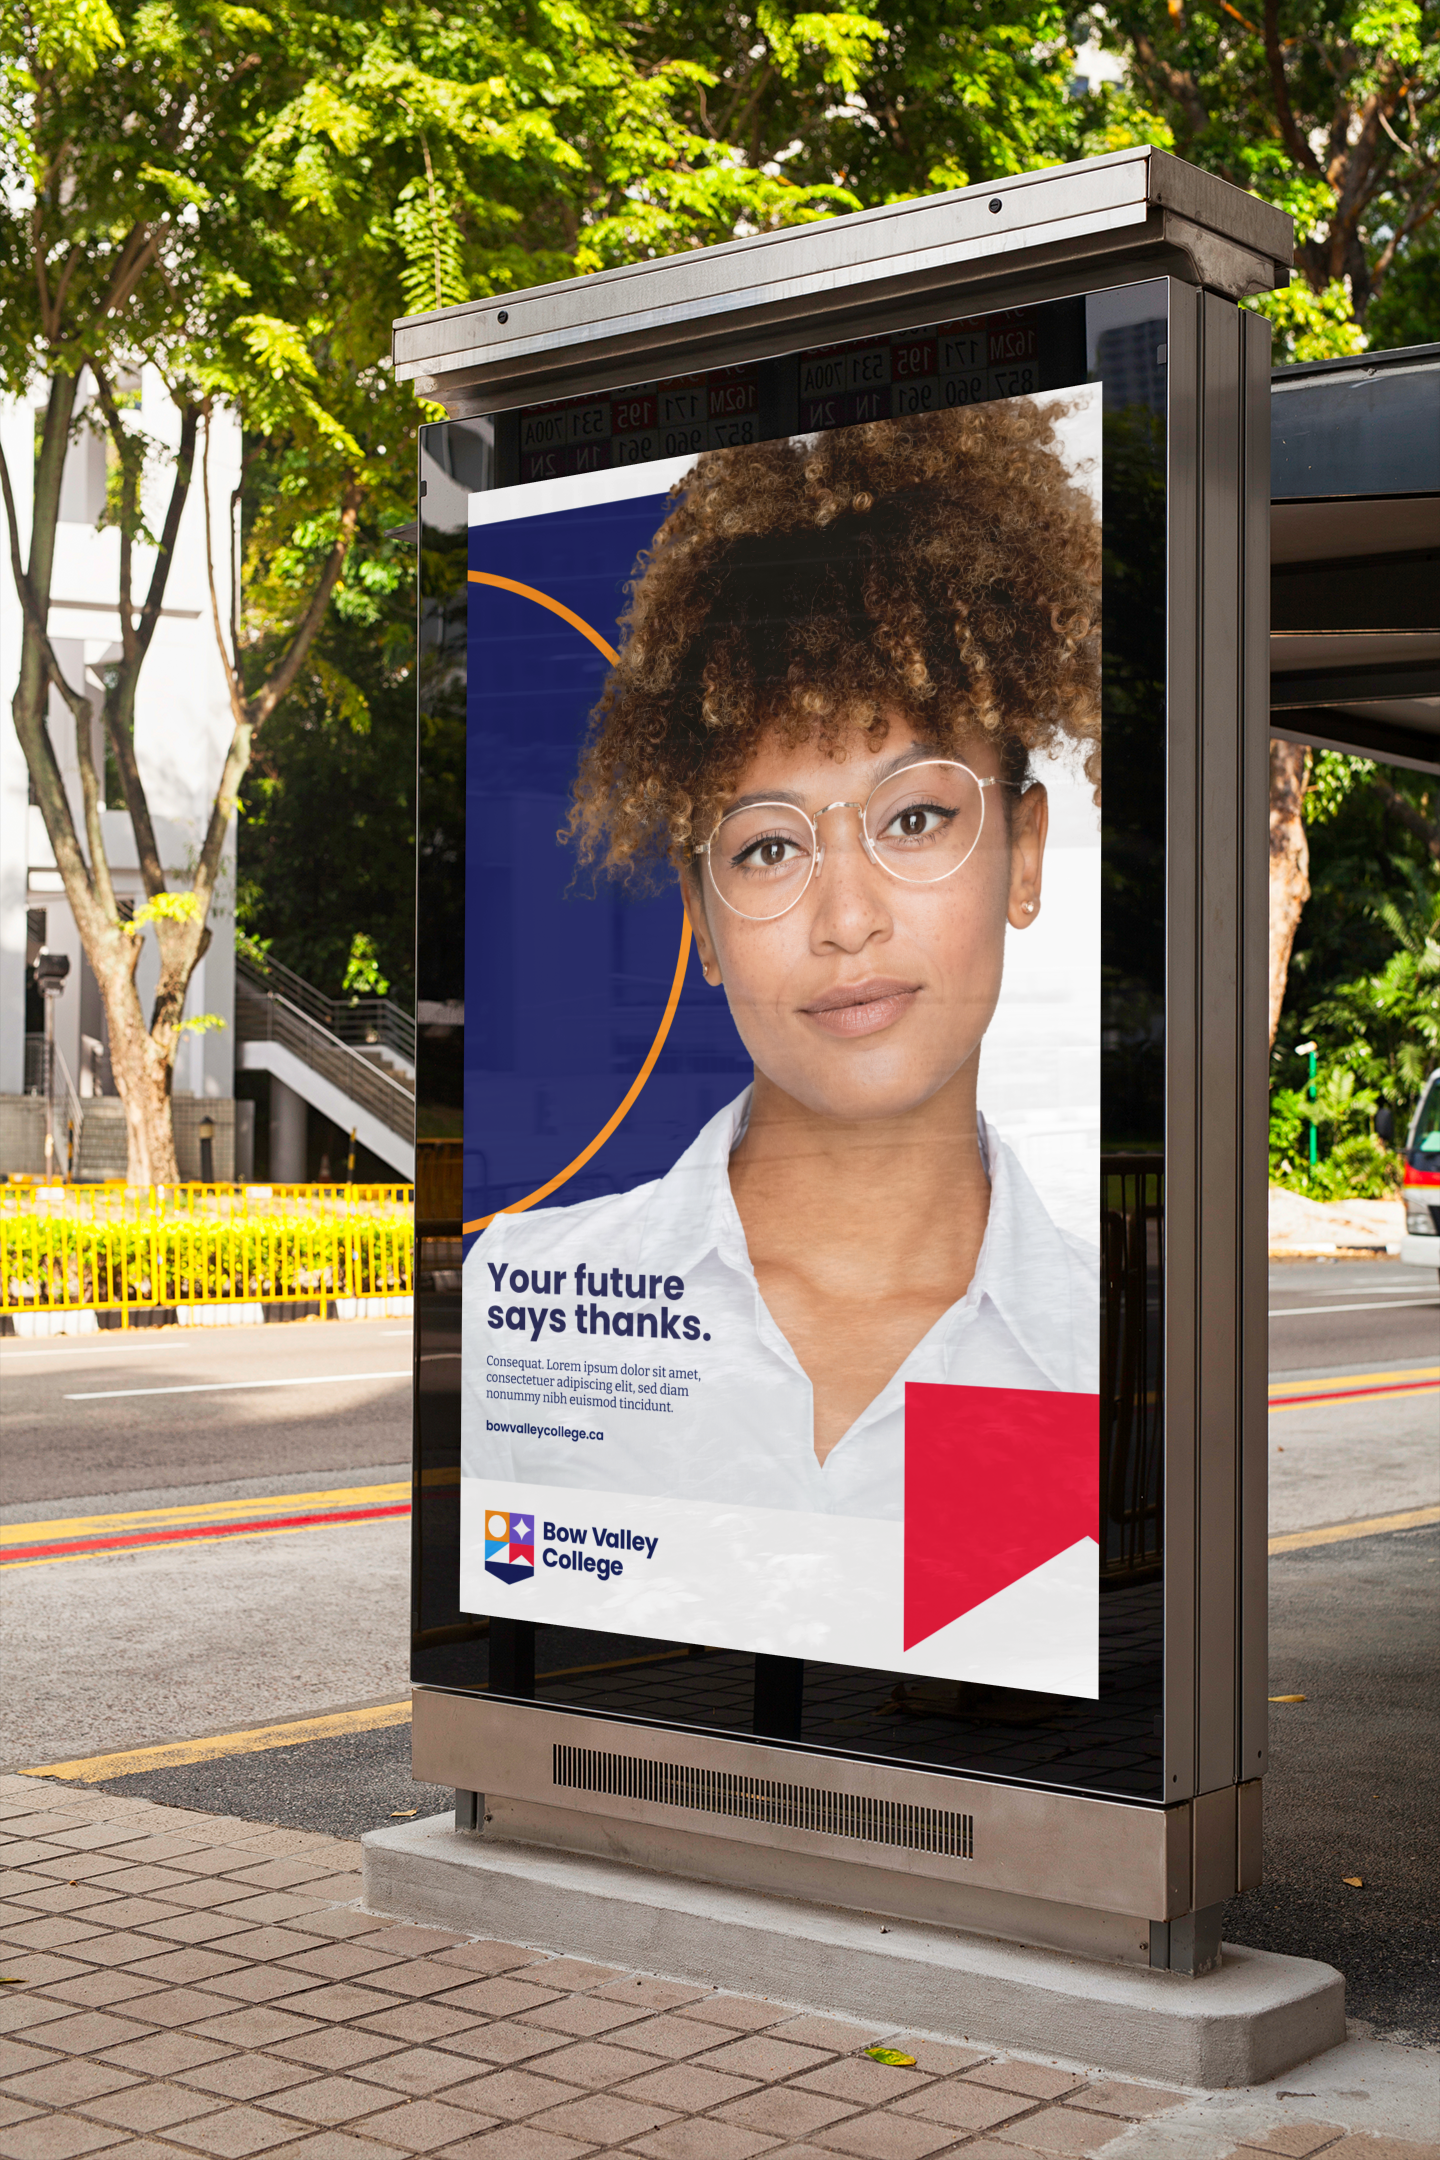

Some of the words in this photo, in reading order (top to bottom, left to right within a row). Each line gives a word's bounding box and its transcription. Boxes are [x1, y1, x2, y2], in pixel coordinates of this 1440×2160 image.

[487, 1262, 566, 1295] Your
[574, 1263, 684, 1301] future
[487, 1305, 566, 1342] says
[575, 1303, 711, 1341] thanks.
[486, 1355, 544, 1370] Consequat.
[547, 1359, 581, 1372] Lorem
[584, 1361, 618, 1375] ipsum
[620, 1363, 650, 1377] dolor
[652, 1366, 666, 1378] sit
[668, 1369, 701, 1381] amet,
[486, 1372, 555, 1387] consectetuer
[557, 1377, 612, 1394] adipiscing
[615, 1380, 636, 1394] elit,
[638, 1383, 657, 1394] sed
[660, 1383, 689, 1396] diam
[486, 1389, 540, 1404] nonummy
[543, 1392, 567, 1404] nibh
[570, 1395, 616, 1408] euismod
[619, 1398, 673, 1413] tincidunt.
[486, 1420, 604, 1442] bowvalleycollege.ca
[544, 1522, 587, 1544] Bow
[592, 1527, 659, 1559] Valley
[543, 1548, 623, 1581] College
